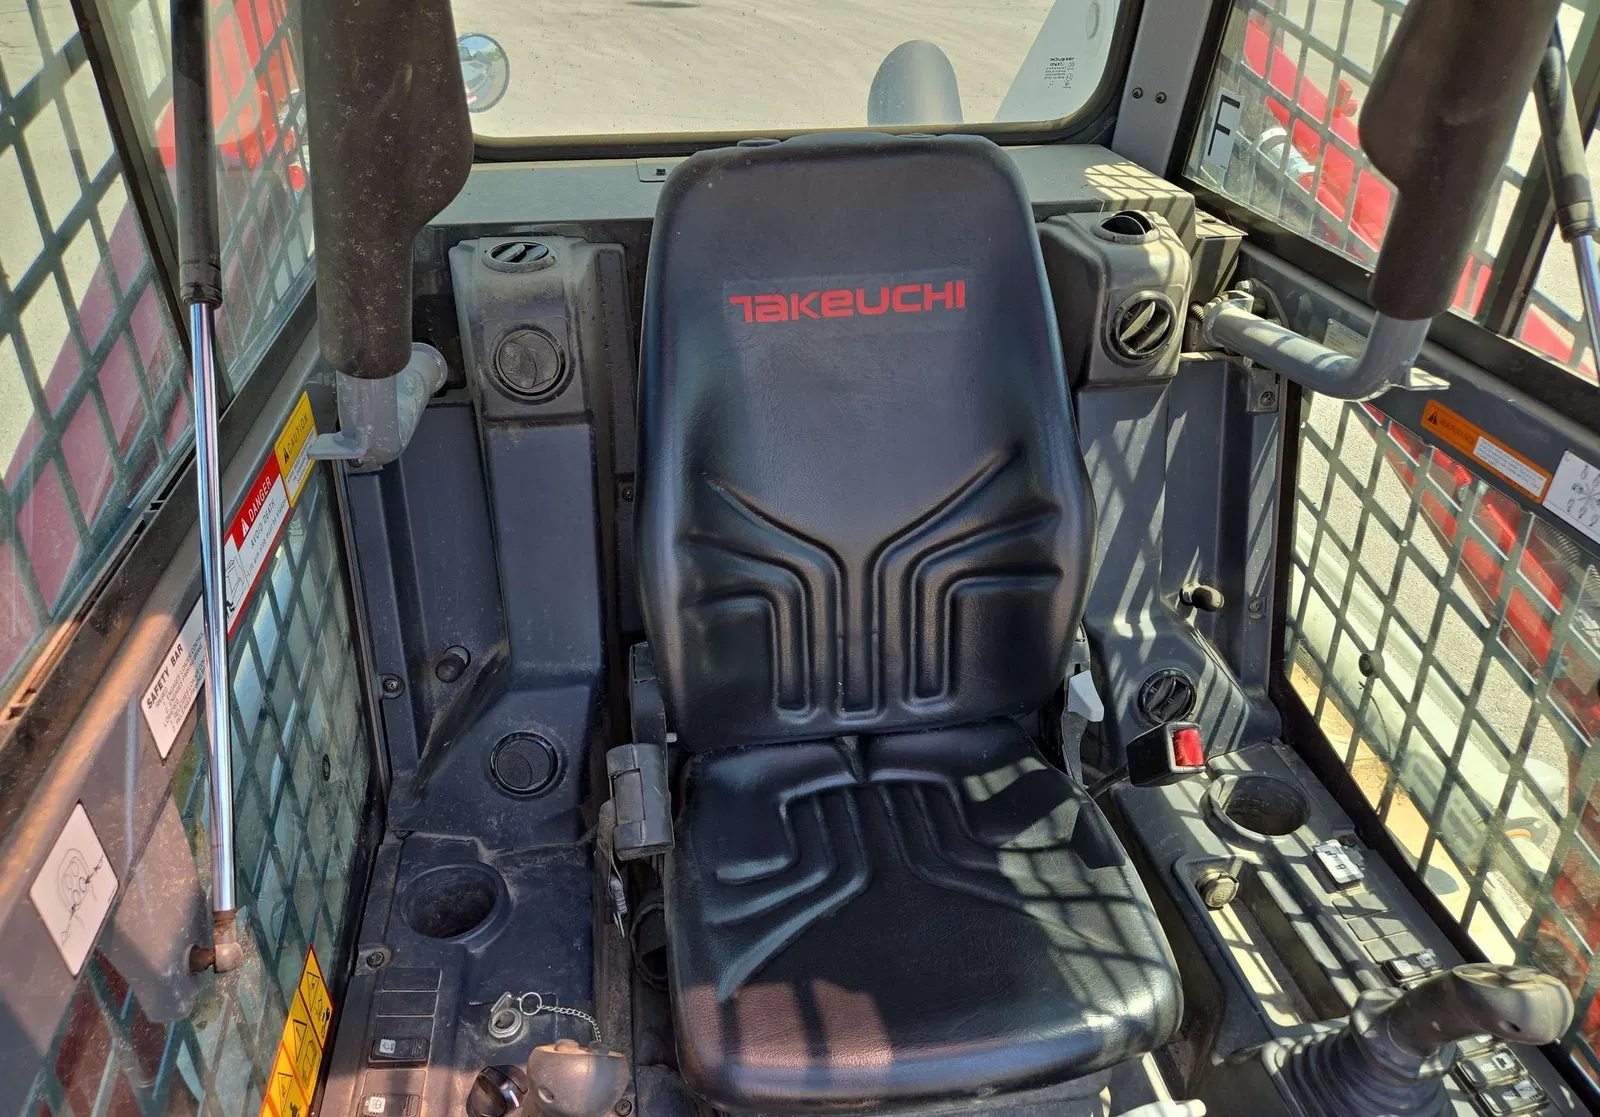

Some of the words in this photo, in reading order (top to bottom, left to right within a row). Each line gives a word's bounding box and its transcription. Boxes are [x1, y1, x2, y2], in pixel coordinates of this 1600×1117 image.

[1208, 94, 1240, 156] F
[730, 280, 965, 324] TAKEUCHI
[288, 412, 308, 455] CAUTION
[248, 476, 272, 522] DANGER
[249, 519, 263, 550] AVOID
[262, 496, 275, 525] DEATH
[147, 666, 170, 709] SAFETY
[170, 643, 184, 667] BAR
